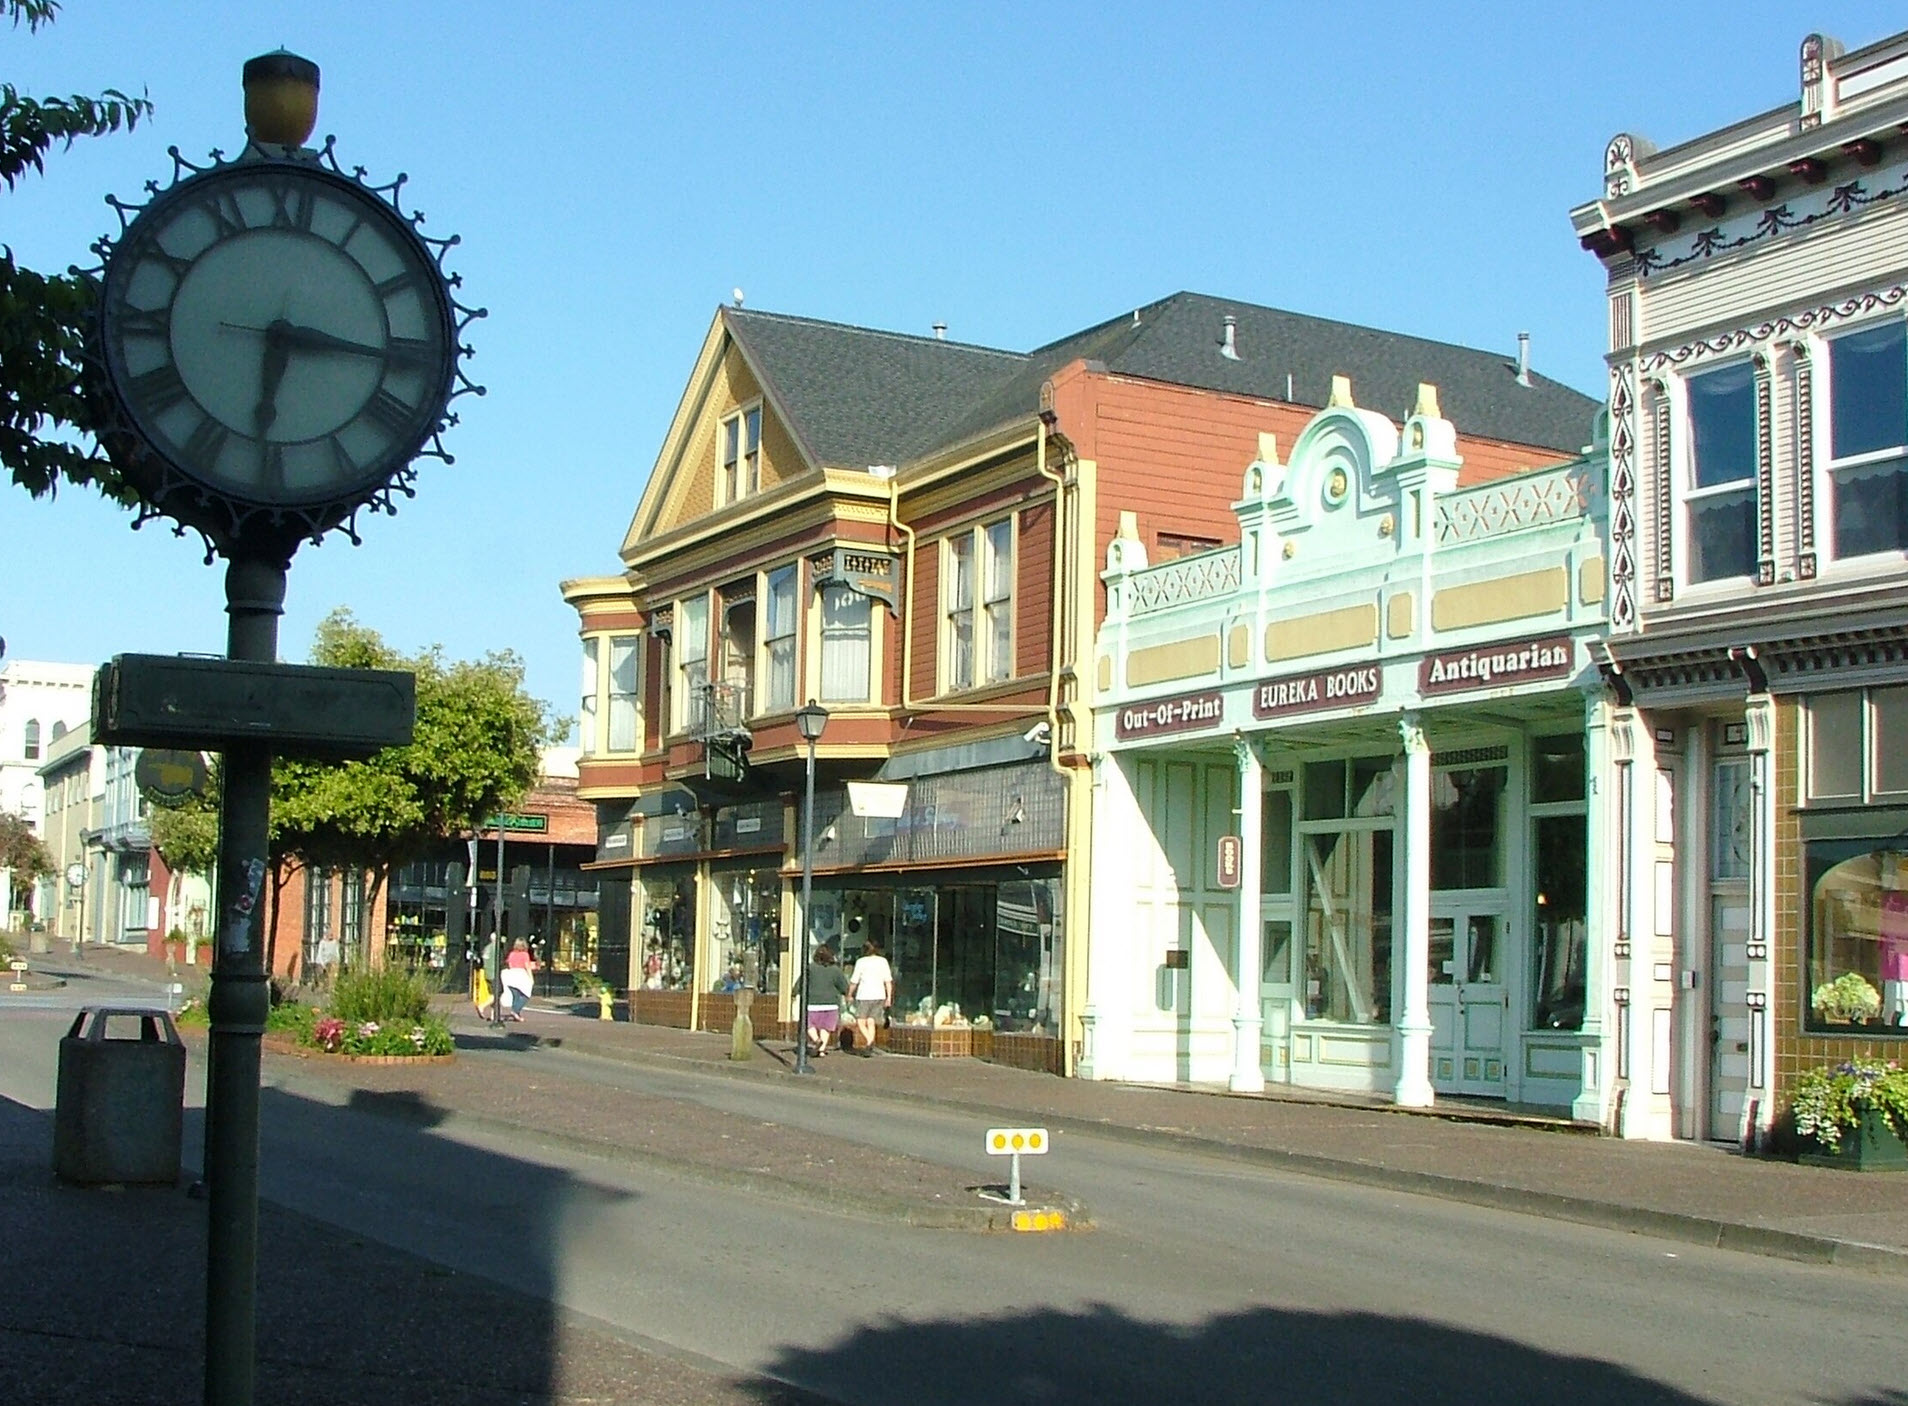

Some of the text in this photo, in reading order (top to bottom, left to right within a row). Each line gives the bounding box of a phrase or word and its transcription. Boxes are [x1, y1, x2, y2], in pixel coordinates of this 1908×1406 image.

[1429, 644, 1567, 681] Antiquarian
[1260, 668, 1378, 709] EUREKA BOOKS
[1123, 698, 1221, 730] Out-Of-Print
